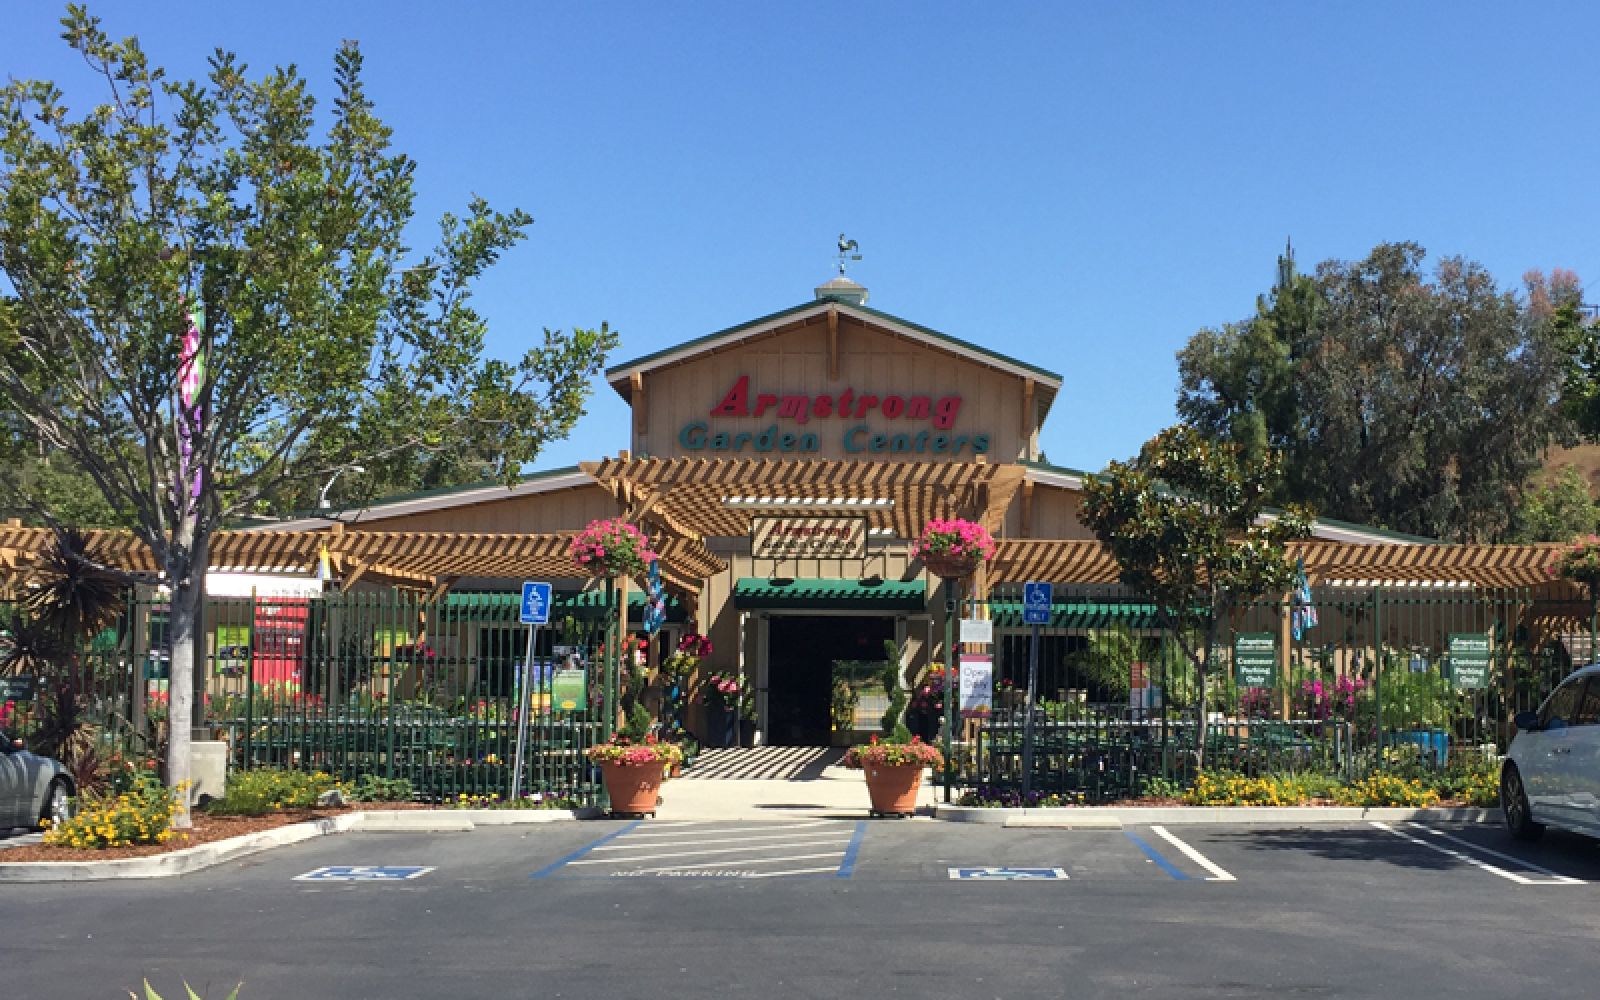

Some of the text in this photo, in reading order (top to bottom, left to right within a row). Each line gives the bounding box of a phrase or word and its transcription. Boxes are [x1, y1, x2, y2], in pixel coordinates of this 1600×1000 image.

[709, 375, 962, 429] Armstrong
[678, 421, 990, 453] Garden Centers
